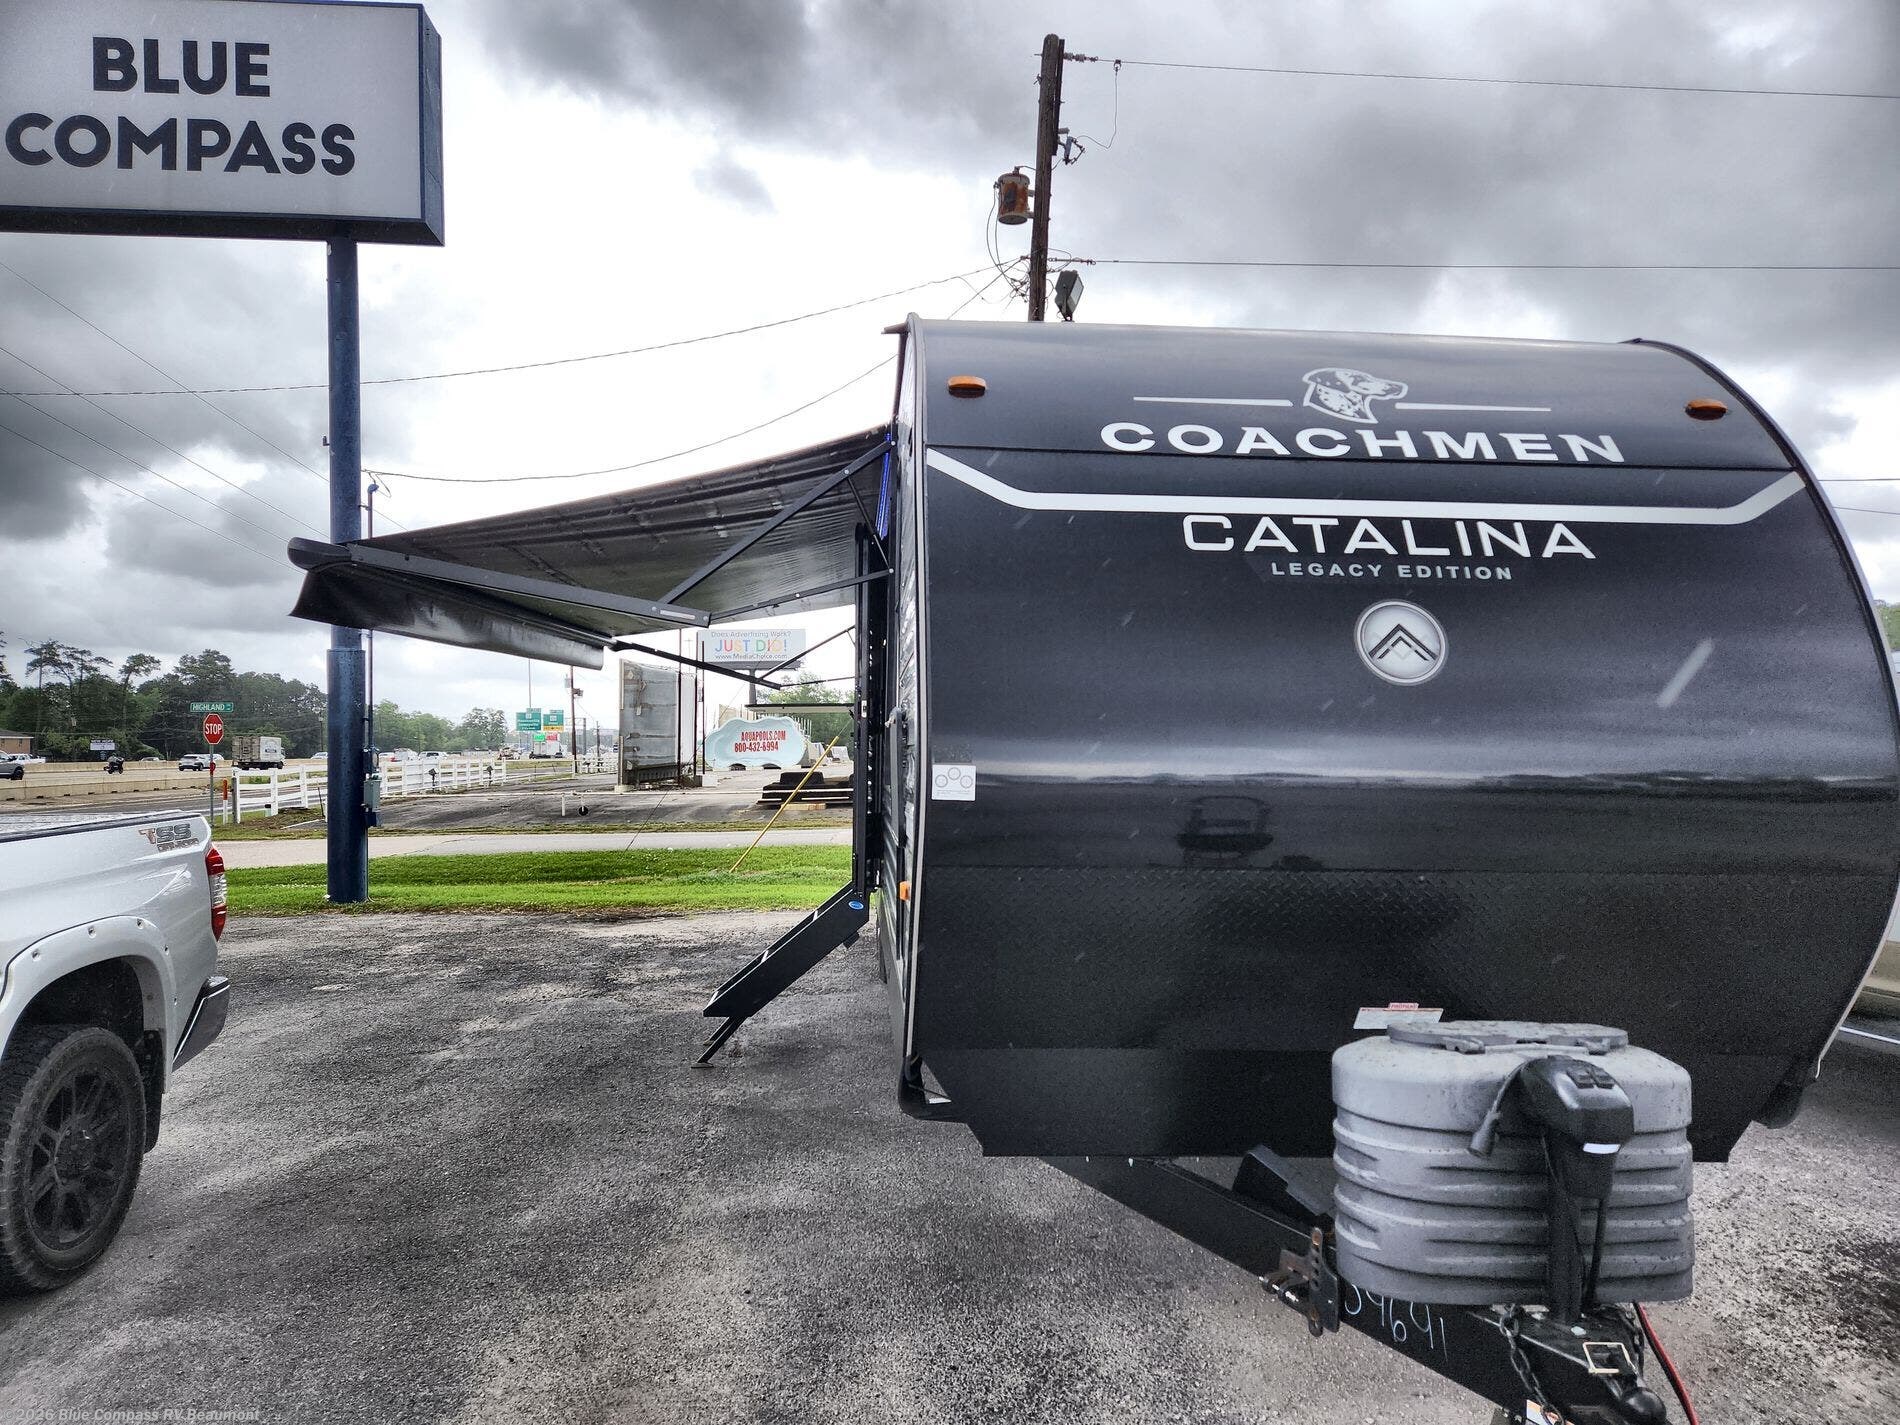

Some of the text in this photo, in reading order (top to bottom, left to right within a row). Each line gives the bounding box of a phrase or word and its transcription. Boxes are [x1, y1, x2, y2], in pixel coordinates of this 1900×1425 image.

[92, 36, 271, 97] BLUE
[5, 112, 356, 176] COMPASS
[1100, 422, 1626, 463] COACHMEN
[1182, 514, 1597, 560] CATALINA
[1272, 562, 1513, 581] LEGACY EDITION
[730, 631, 768, 639] Advertising
[771, 630, 791, 638] Work?
[714, 639, 751, 652] JUST
[192, 703, 225, 711] HIGHLAND
[205, 723, 222, 735] STOP
[741, 730, 786, 741] AQUAPOOLS.COM
